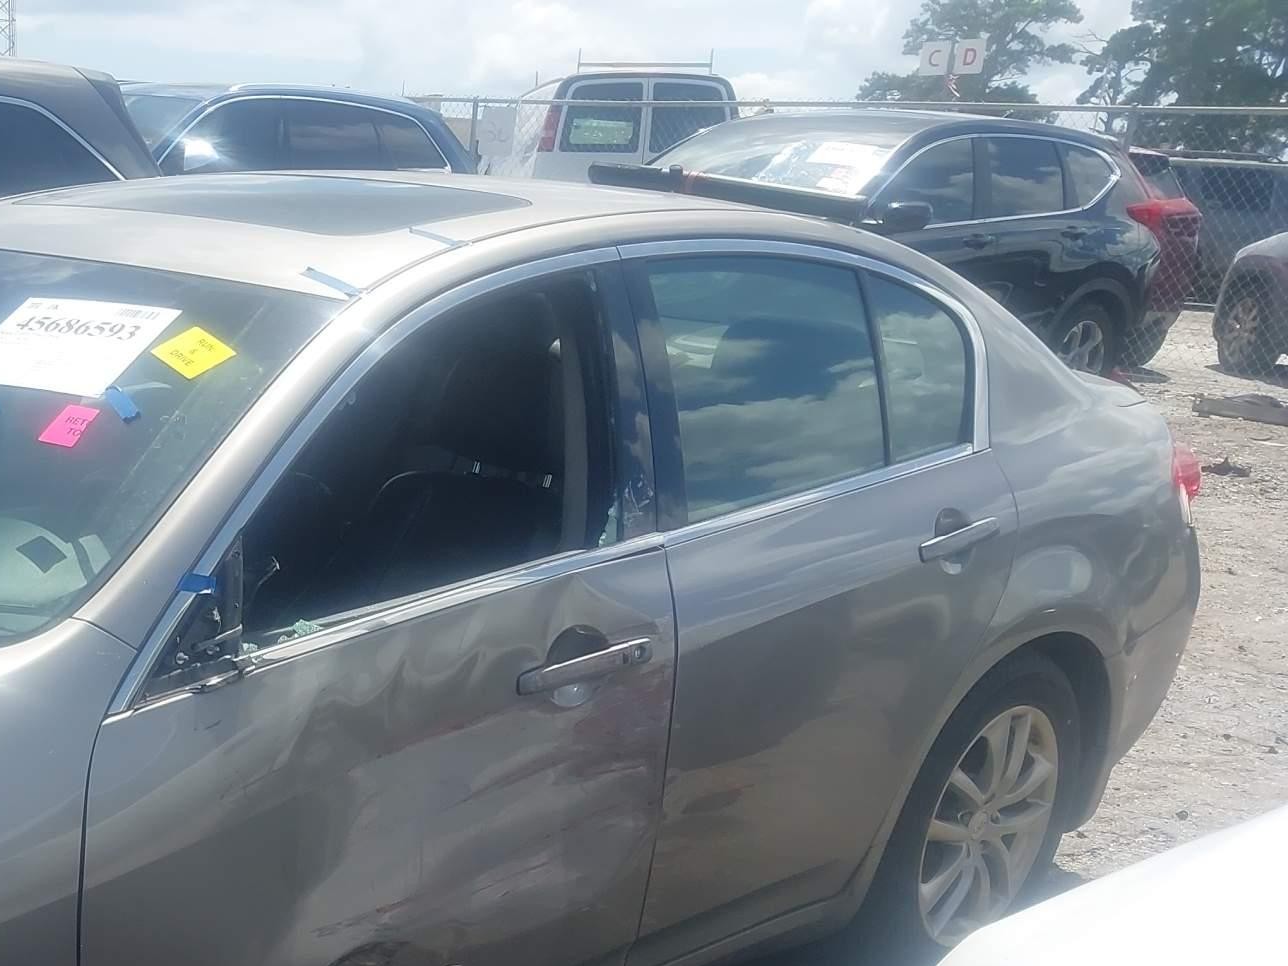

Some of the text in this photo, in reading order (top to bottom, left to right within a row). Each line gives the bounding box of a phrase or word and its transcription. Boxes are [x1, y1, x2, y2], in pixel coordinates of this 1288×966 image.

[928, 49, 942, 67] C
[962, 47, 977, 66] D
[16, 316, 142, 341] 45686593
[169, 349, 196, 367] DRIVE
